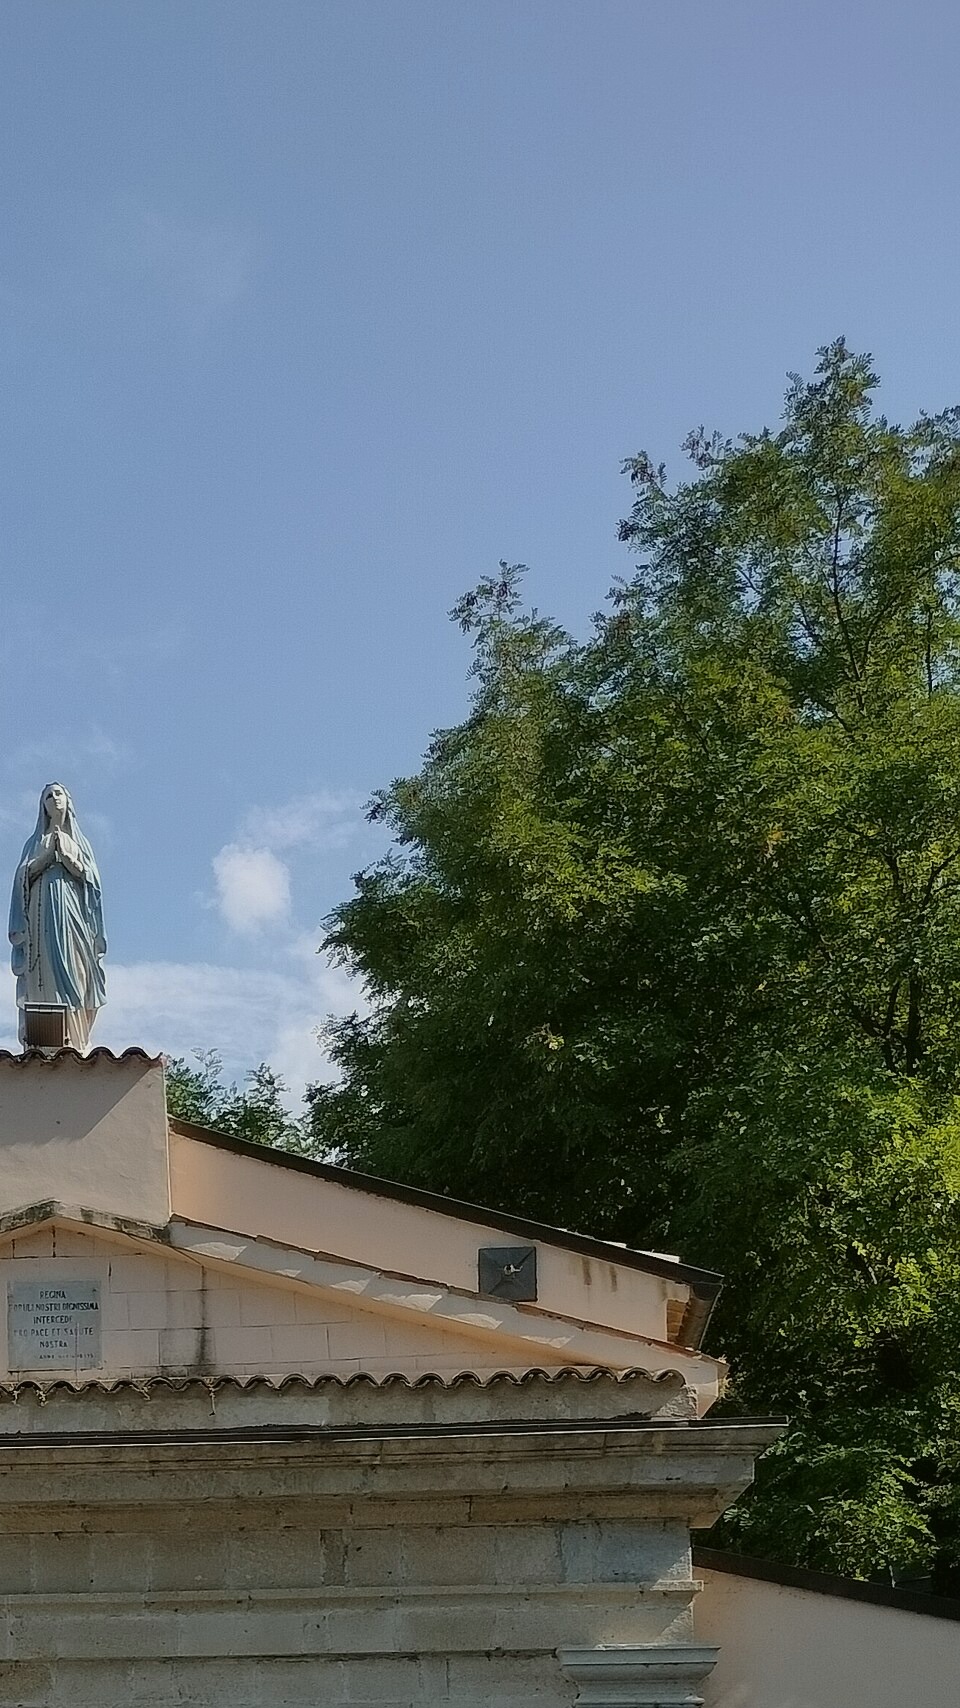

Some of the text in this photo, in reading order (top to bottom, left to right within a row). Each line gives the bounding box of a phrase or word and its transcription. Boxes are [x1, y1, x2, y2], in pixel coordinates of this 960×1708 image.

[40, 1291, 66, 1299] REGINA
[35, 1303, 60, 1311] NOSTRI
[34, 1316, 72, 1324] INTERCEDE
[52, 1328, 60, 1336] ET
[64, 1327, 94, 1336] SALUTE
